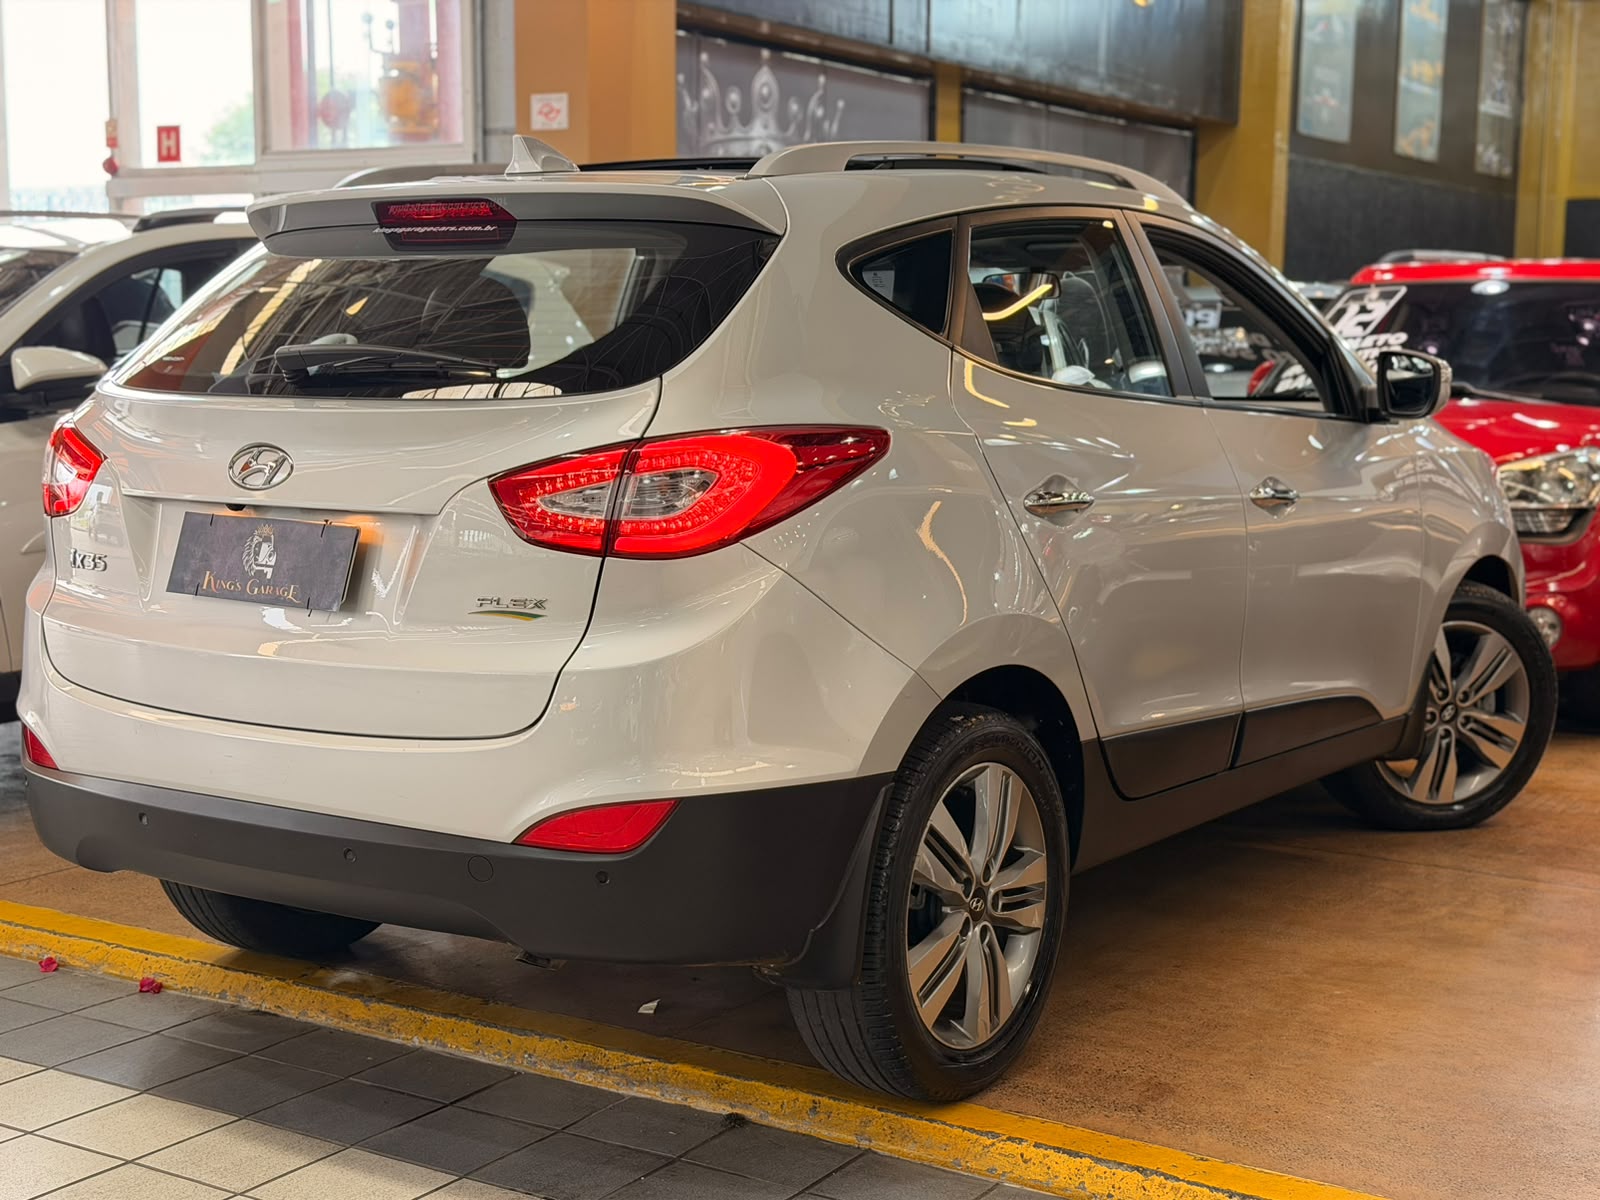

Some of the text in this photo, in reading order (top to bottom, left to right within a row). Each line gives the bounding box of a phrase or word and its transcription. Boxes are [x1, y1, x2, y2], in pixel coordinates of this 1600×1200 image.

[161, 131, 177, 157] H
[1345, 332, 1408, 351] LETO
[246, 578, 301, 604] GARAGE
[476, 597, 548, 610] FLEX
